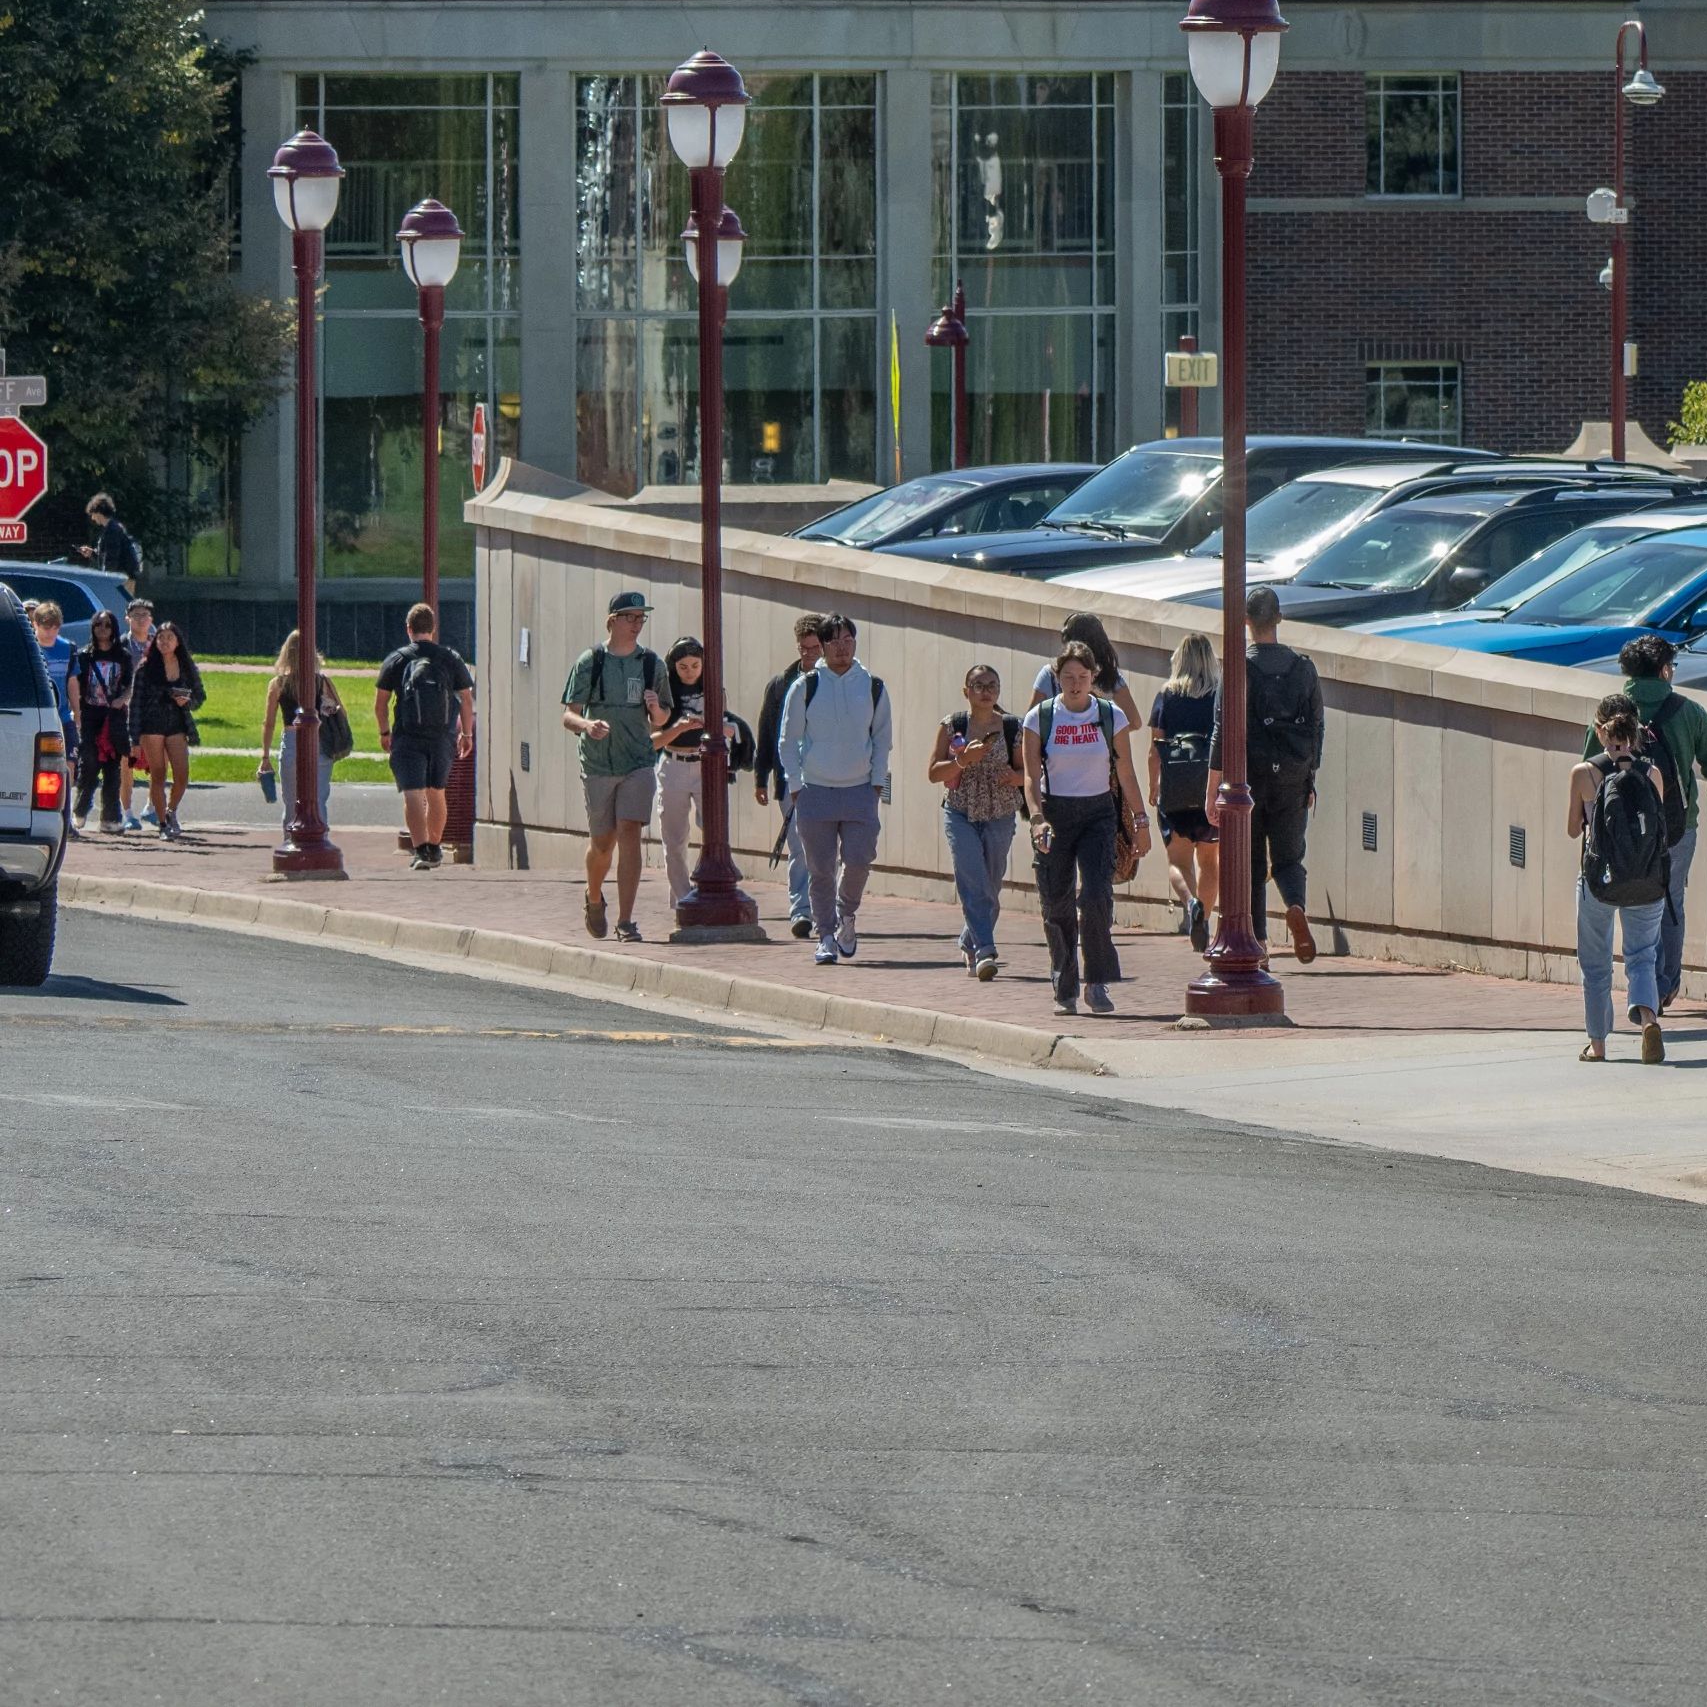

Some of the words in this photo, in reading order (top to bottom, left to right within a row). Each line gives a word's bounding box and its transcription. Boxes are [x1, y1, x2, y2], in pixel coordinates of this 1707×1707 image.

[1179, 359, 1210, 382] EXIT
[25, 386, 41, 397] Ave
[1056, 725, 1078, 735] GOOD
[1055, 735, 1069, 745] BIG
[1072, 733, 1099, 744] HEART
